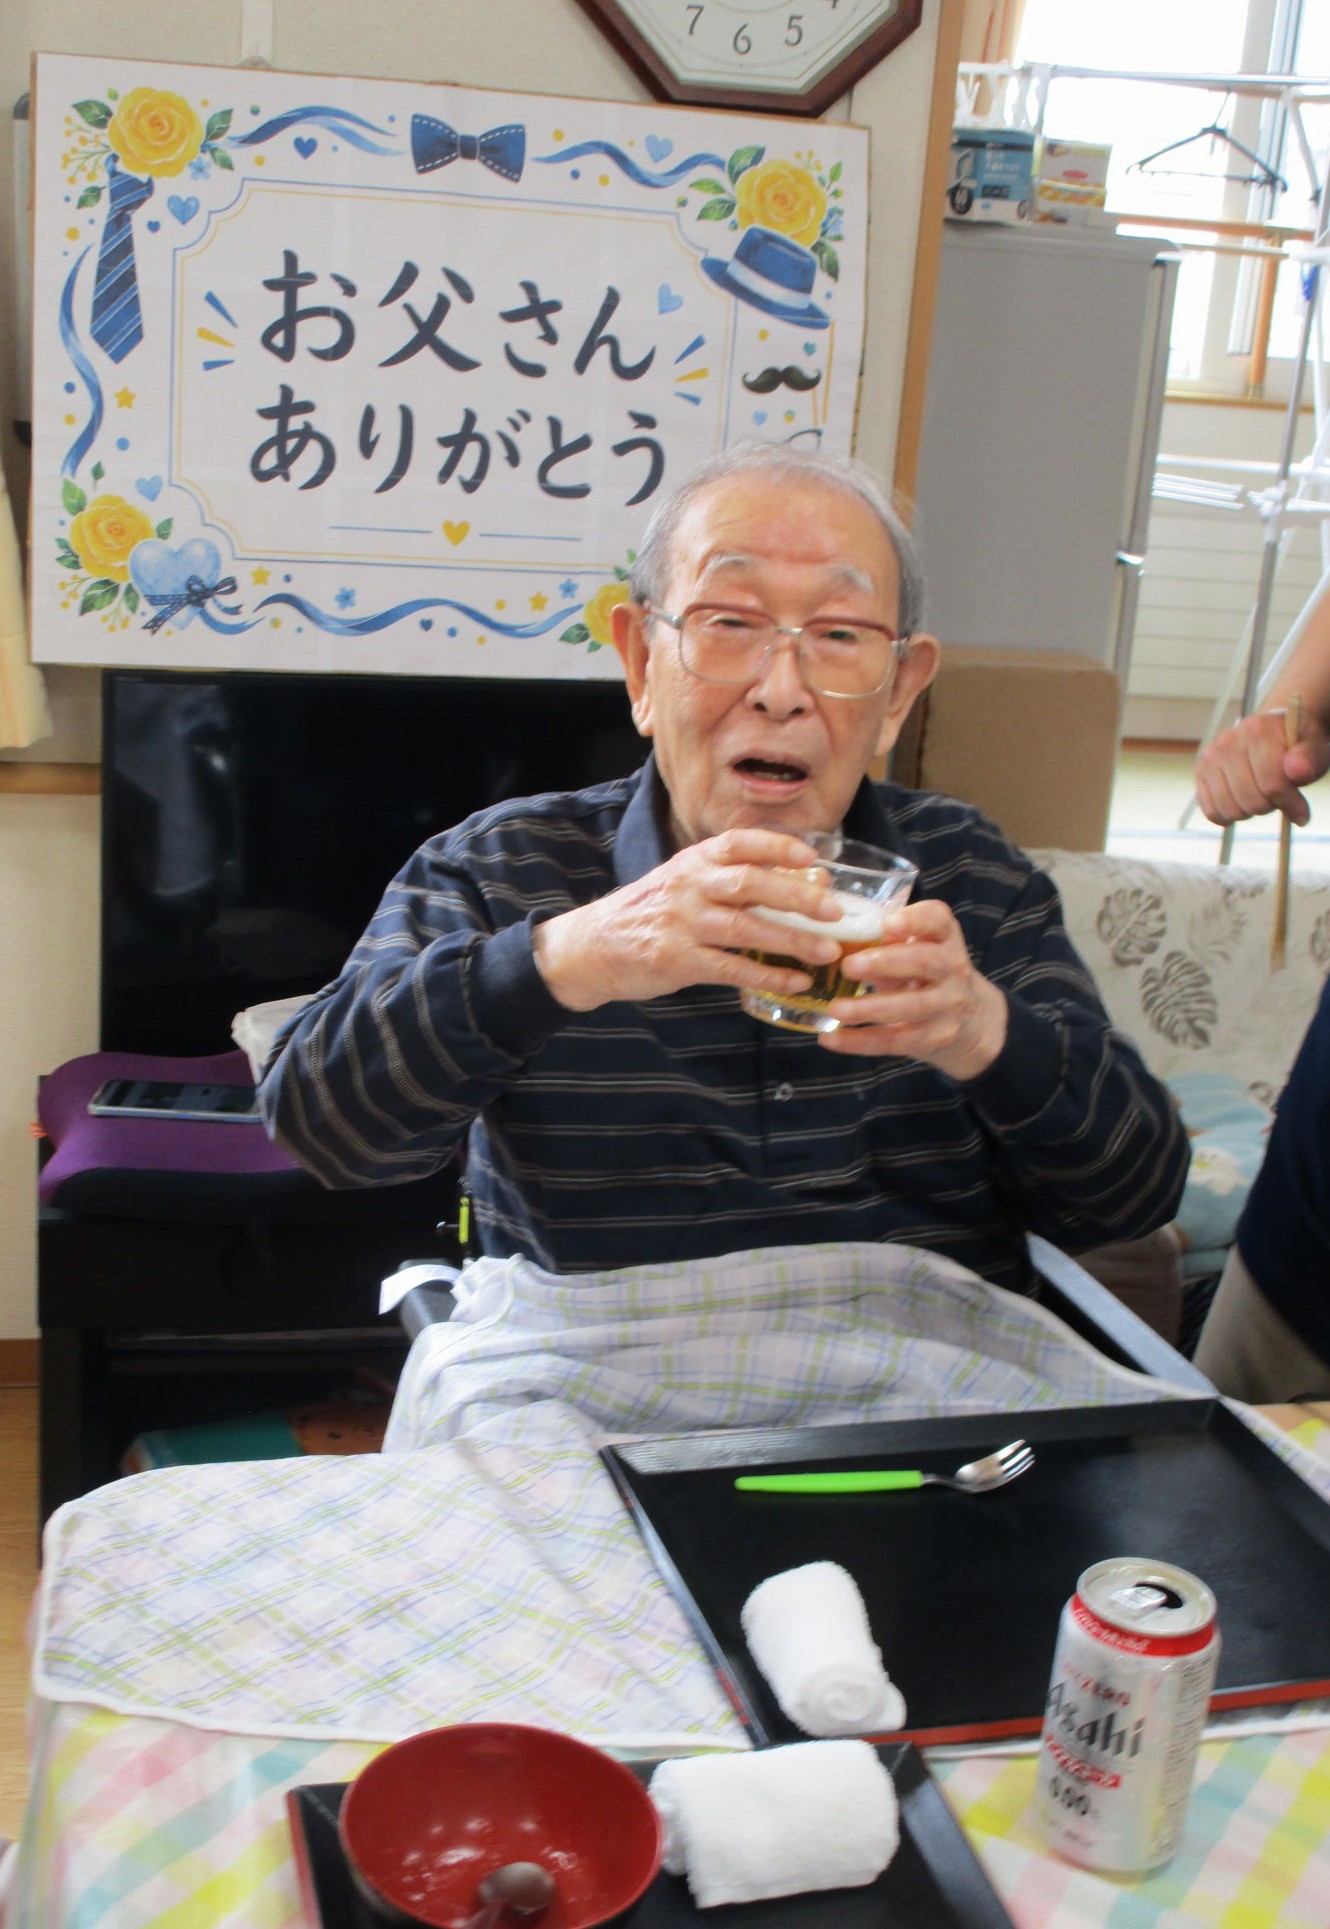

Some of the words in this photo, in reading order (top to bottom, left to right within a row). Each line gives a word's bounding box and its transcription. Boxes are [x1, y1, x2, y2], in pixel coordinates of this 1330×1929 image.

[685, 5, 705, 36] 7
[733, 23, 752, 56] 6
[784, 15, 804, 47] 5
[261, 250, 657, 380] お父さん
[250, 384, 665, 506] ありがとう
[1047, 1682, 1146, 1759] Asahi
